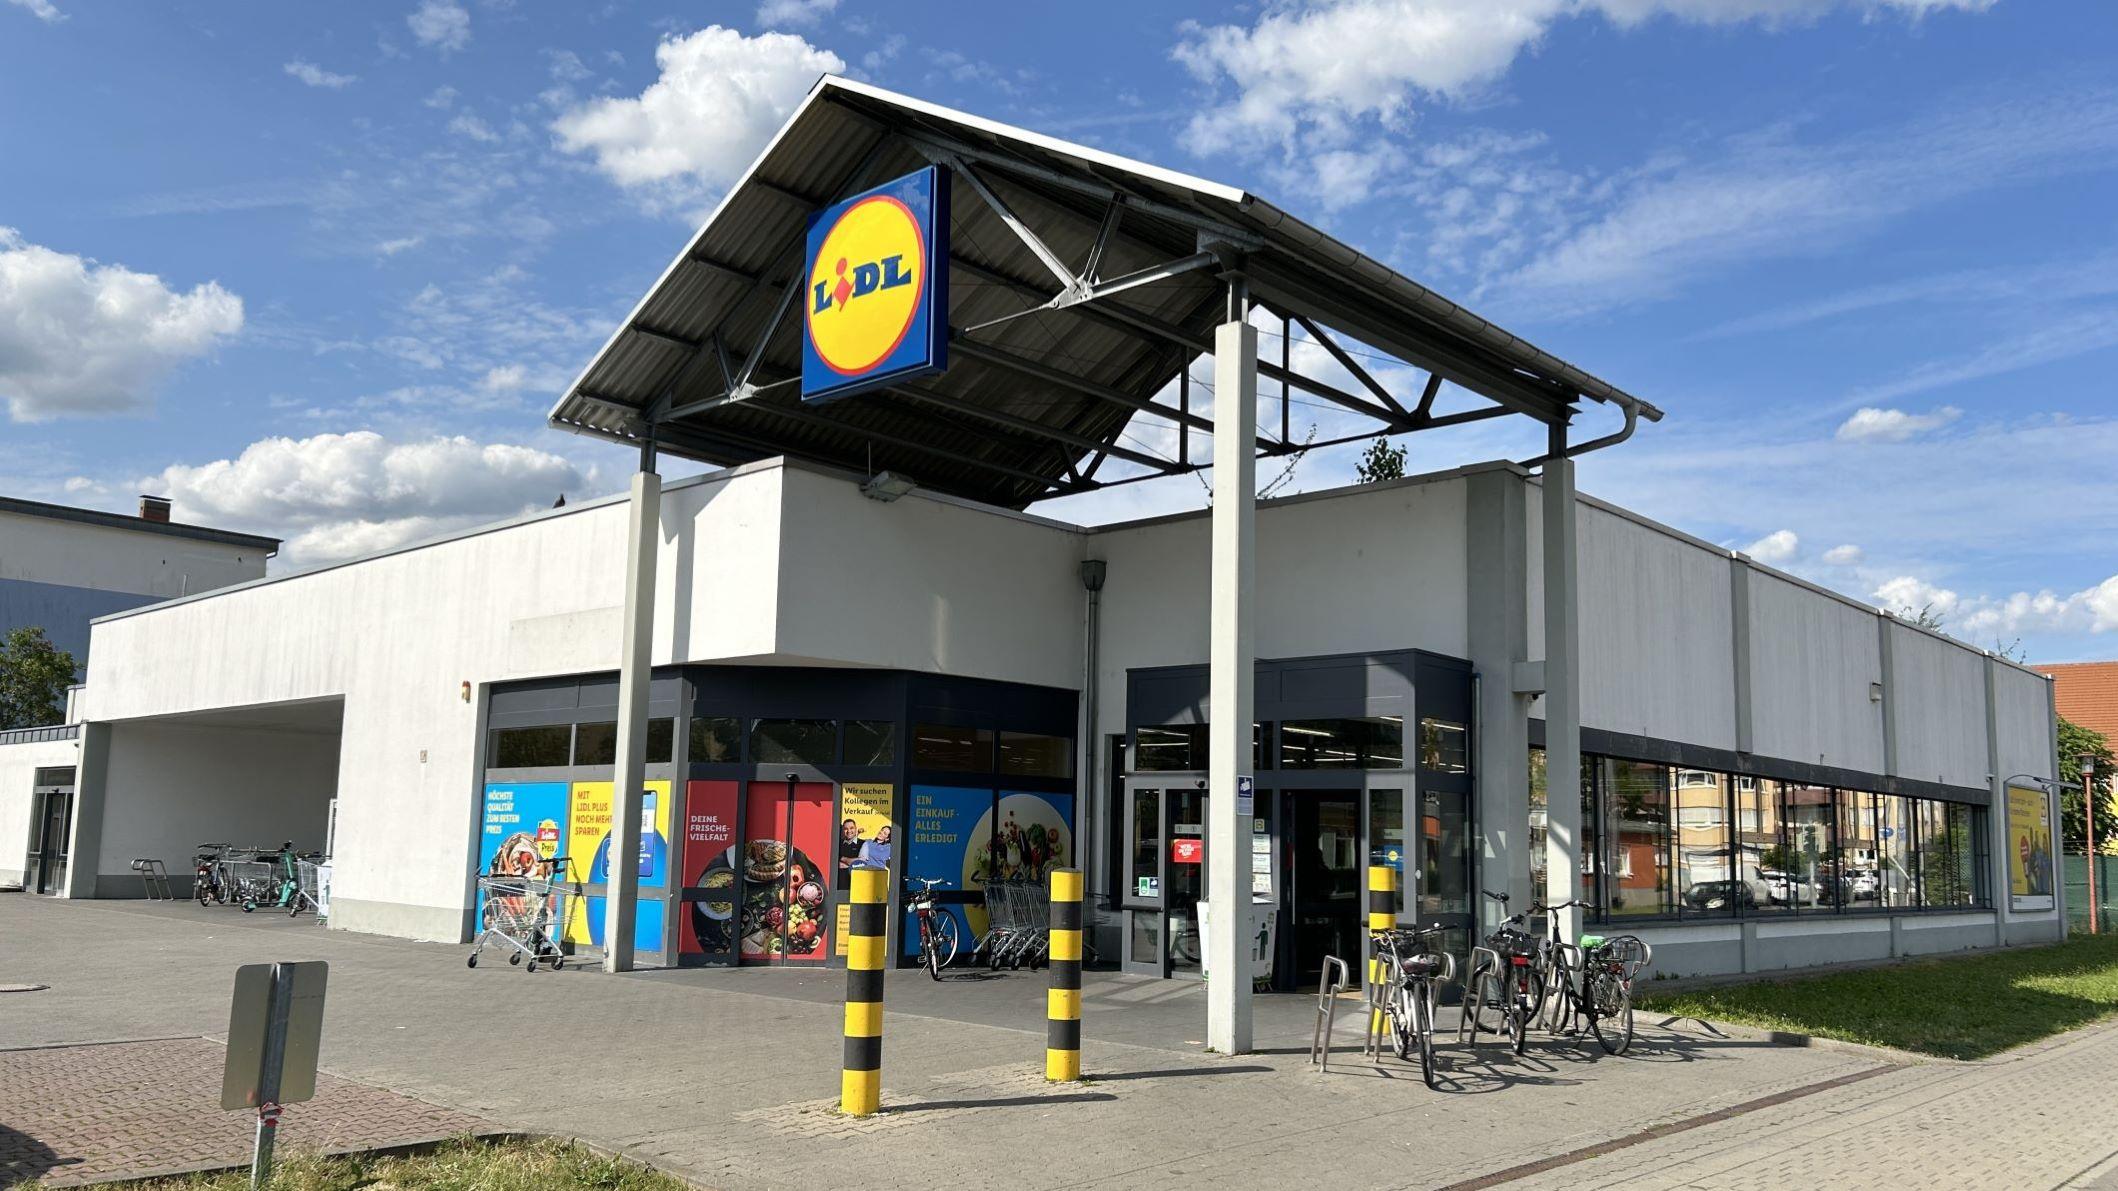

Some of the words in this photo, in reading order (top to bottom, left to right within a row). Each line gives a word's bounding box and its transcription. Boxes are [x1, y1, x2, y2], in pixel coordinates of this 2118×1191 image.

[577, 790, 590, 800] MIT
[860, 787, 887, 795] suchen
[844, 797, 878, 806] Kollegen
[916, 795, 932, 805] EIN
[576, 802, 591, 812] LIDL
[592, 802, 608, 812] PLUS
[844, 807, 873, 815] Verkauf
[575, 814, 595, 824] NOCH
[691, 815, 718, 823] DEINE
[690, 824, 731, 832] FRISCHE-
[915, 820, 942, 831] ALLES
[574, 826, 600, 836] SPAREN
[689, 833, 729, 841] VIELFALT
[914, 833, 958, 843] ERLEDIGT
